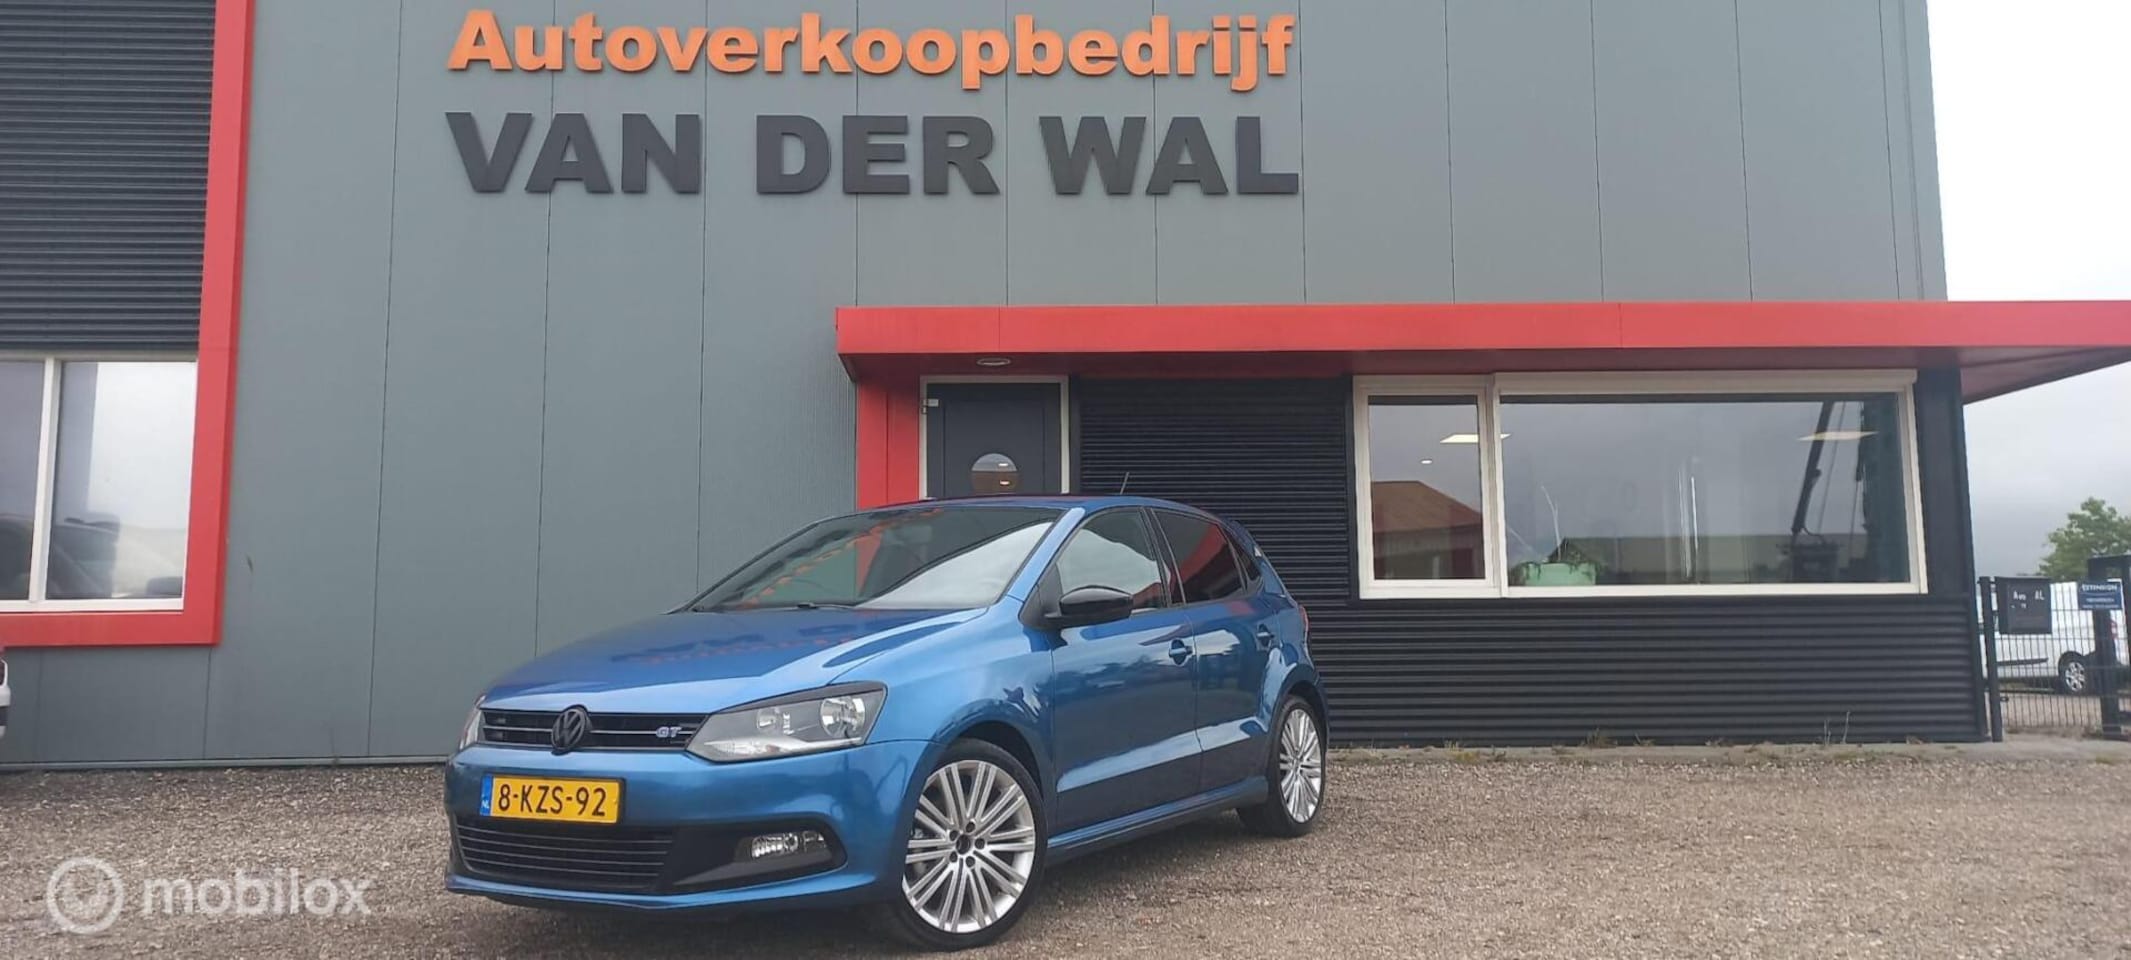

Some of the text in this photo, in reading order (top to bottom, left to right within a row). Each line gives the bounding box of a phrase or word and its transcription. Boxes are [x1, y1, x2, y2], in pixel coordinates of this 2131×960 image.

[447, 9, 1296, 91] Autoverkoopbedrijf
[445, 111, 1299, 195] VAN DER WAL
[656, 726, 682, 738] GT
[498, 784, 607, 816] 8-KZS-92
